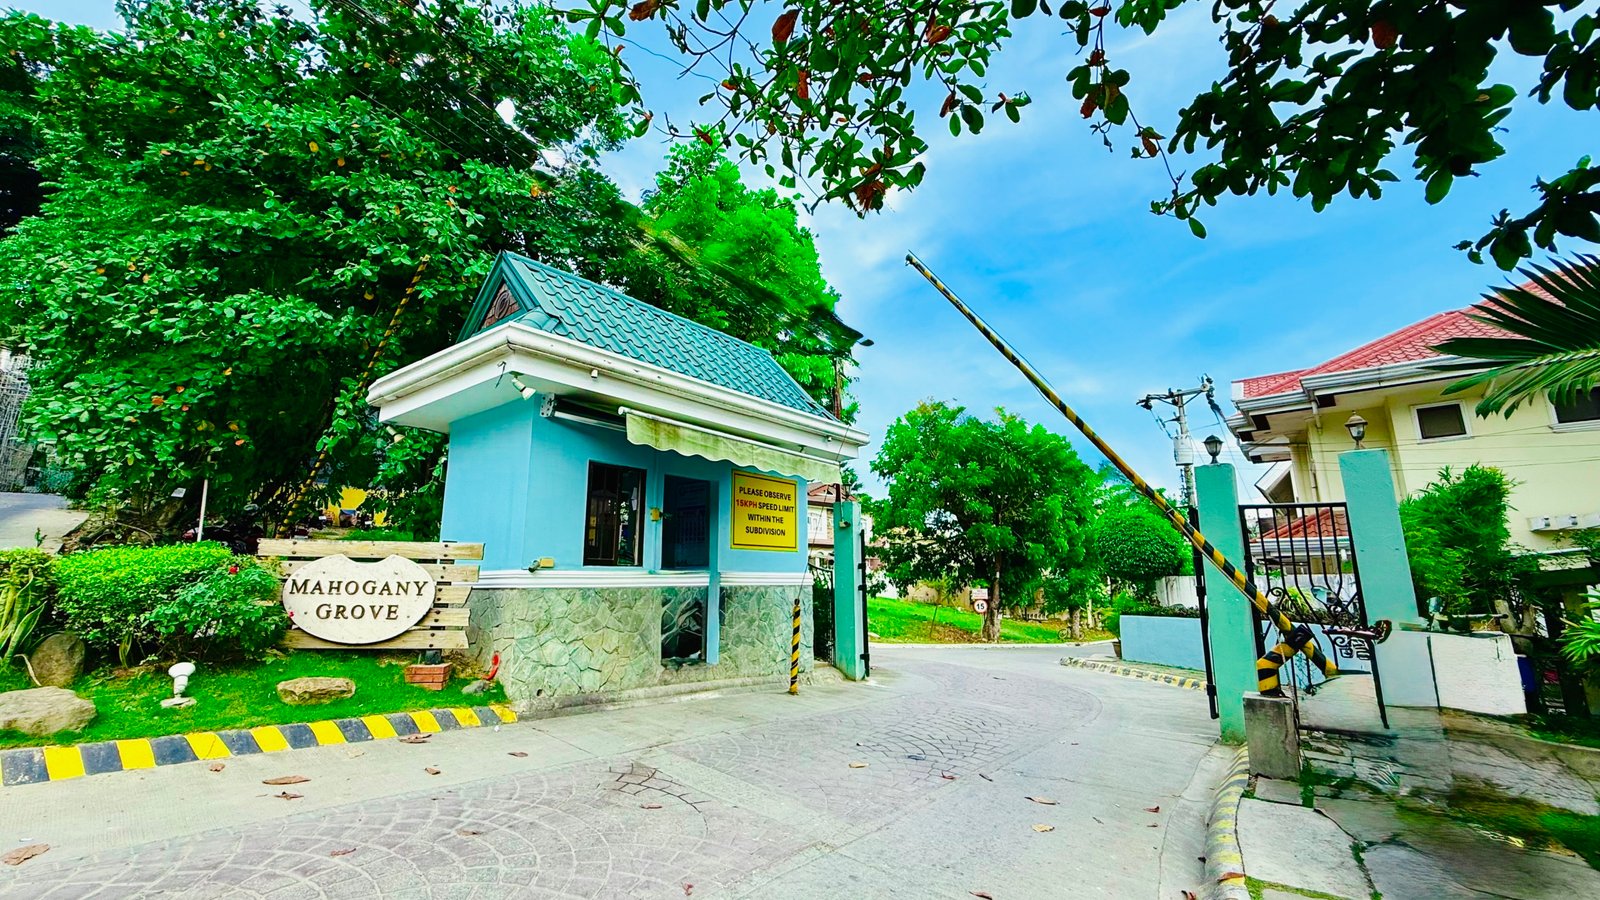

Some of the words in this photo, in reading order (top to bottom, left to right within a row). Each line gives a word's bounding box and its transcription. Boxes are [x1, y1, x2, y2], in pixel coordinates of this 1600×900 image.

[739, 487, 763, 497] PLEASE
[764, 491, 791, 501] OBSERVE
[736, 499, 757, 508] 15KPH
[758, 502, 778, 510] SPEED
[748, 513, 771, 522] WITHIN
[772, 516, 784, 524] THE
[745, 526, 785, 536] SUBDIVISION
[289, 579, 428, 596] MAHOGANY
[316, 603, 400, 620] GROVE
